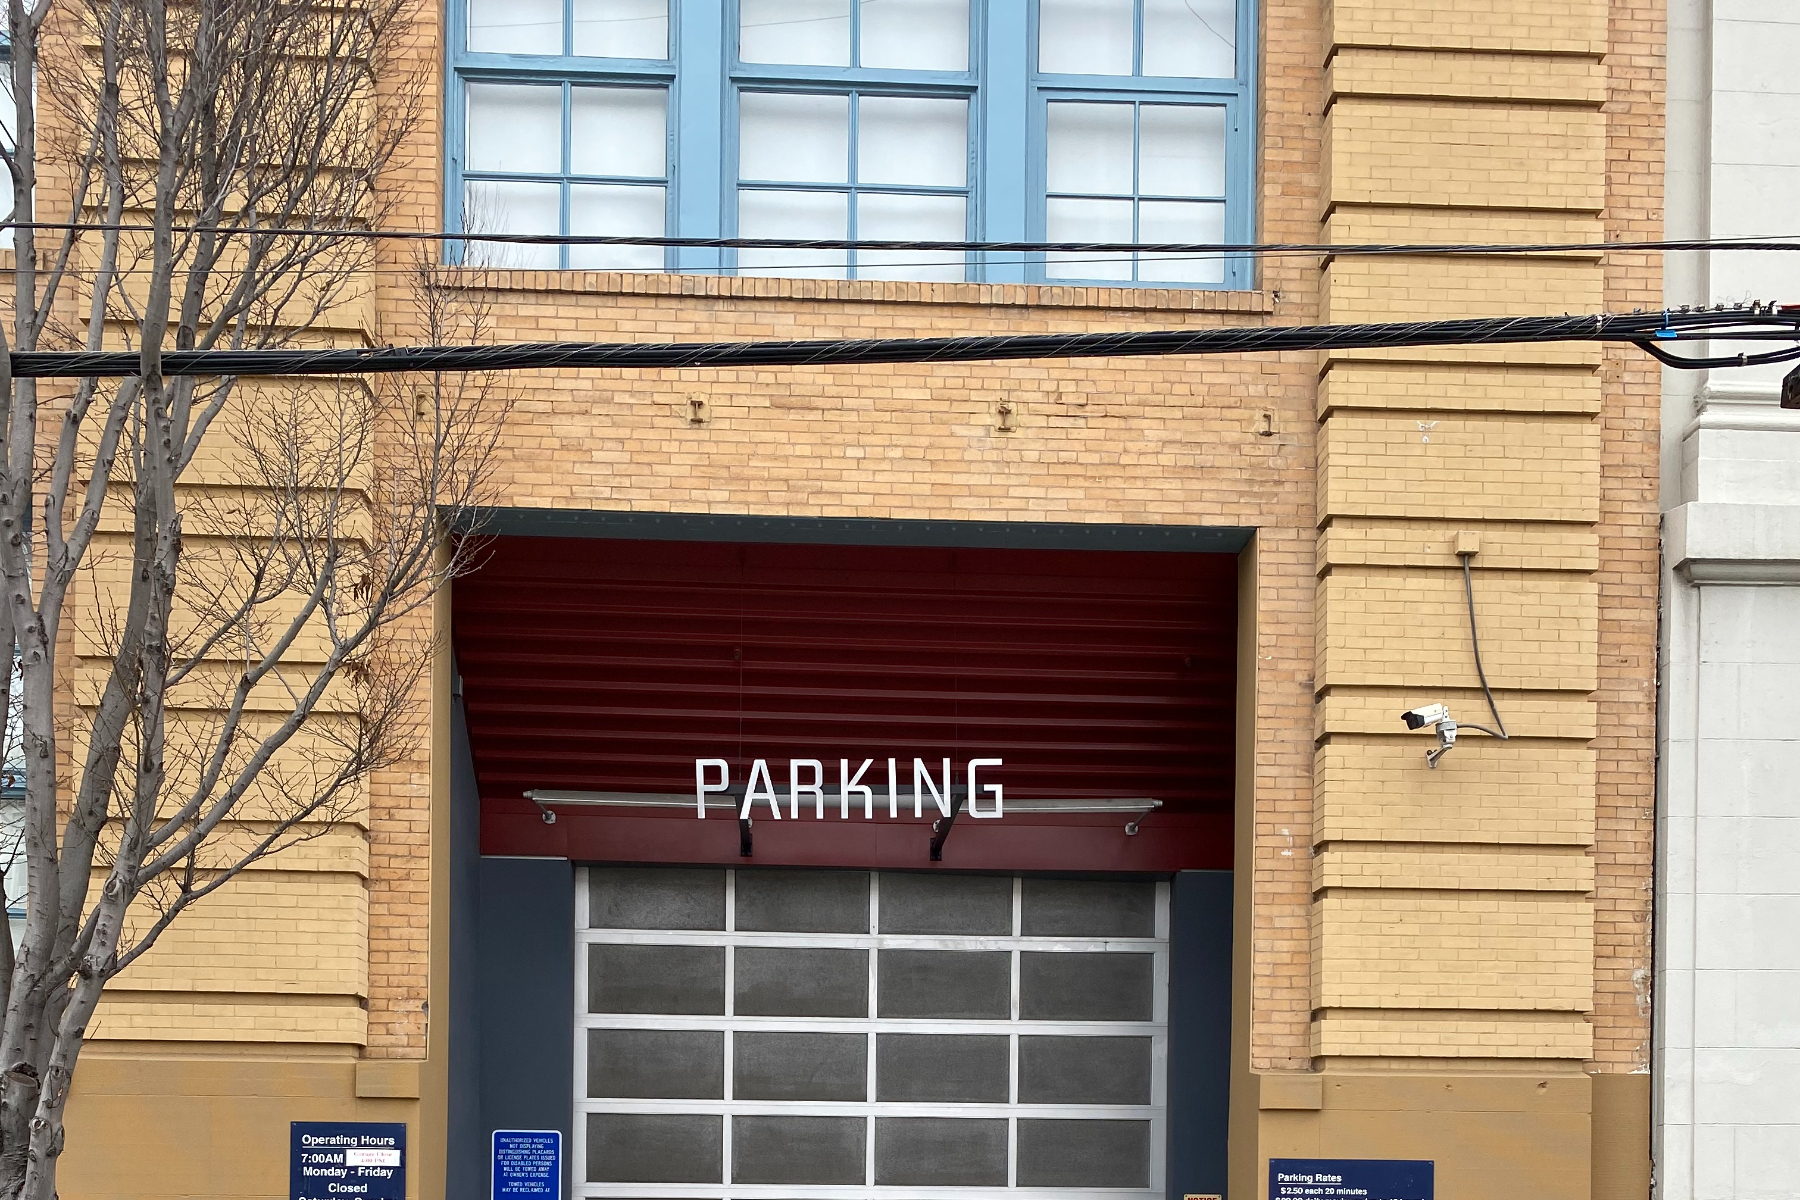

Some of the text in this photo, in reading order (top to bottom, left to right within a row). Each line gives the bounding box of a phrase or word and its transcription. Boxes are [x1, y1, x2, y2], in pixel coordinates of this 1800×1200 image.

[695, 758, 1003, 820] PARKING
[302, 1135, 395, 1146] Operating Hours
[301, 1154, 343, 1163] 7:00AM
[303, 1167, 347, 1178] Monday
[358, 1167, 393, 1178] Friday
[1278, 1174, 1313, 1183] Parking
[328, 1183, 367, 1192] Closed
